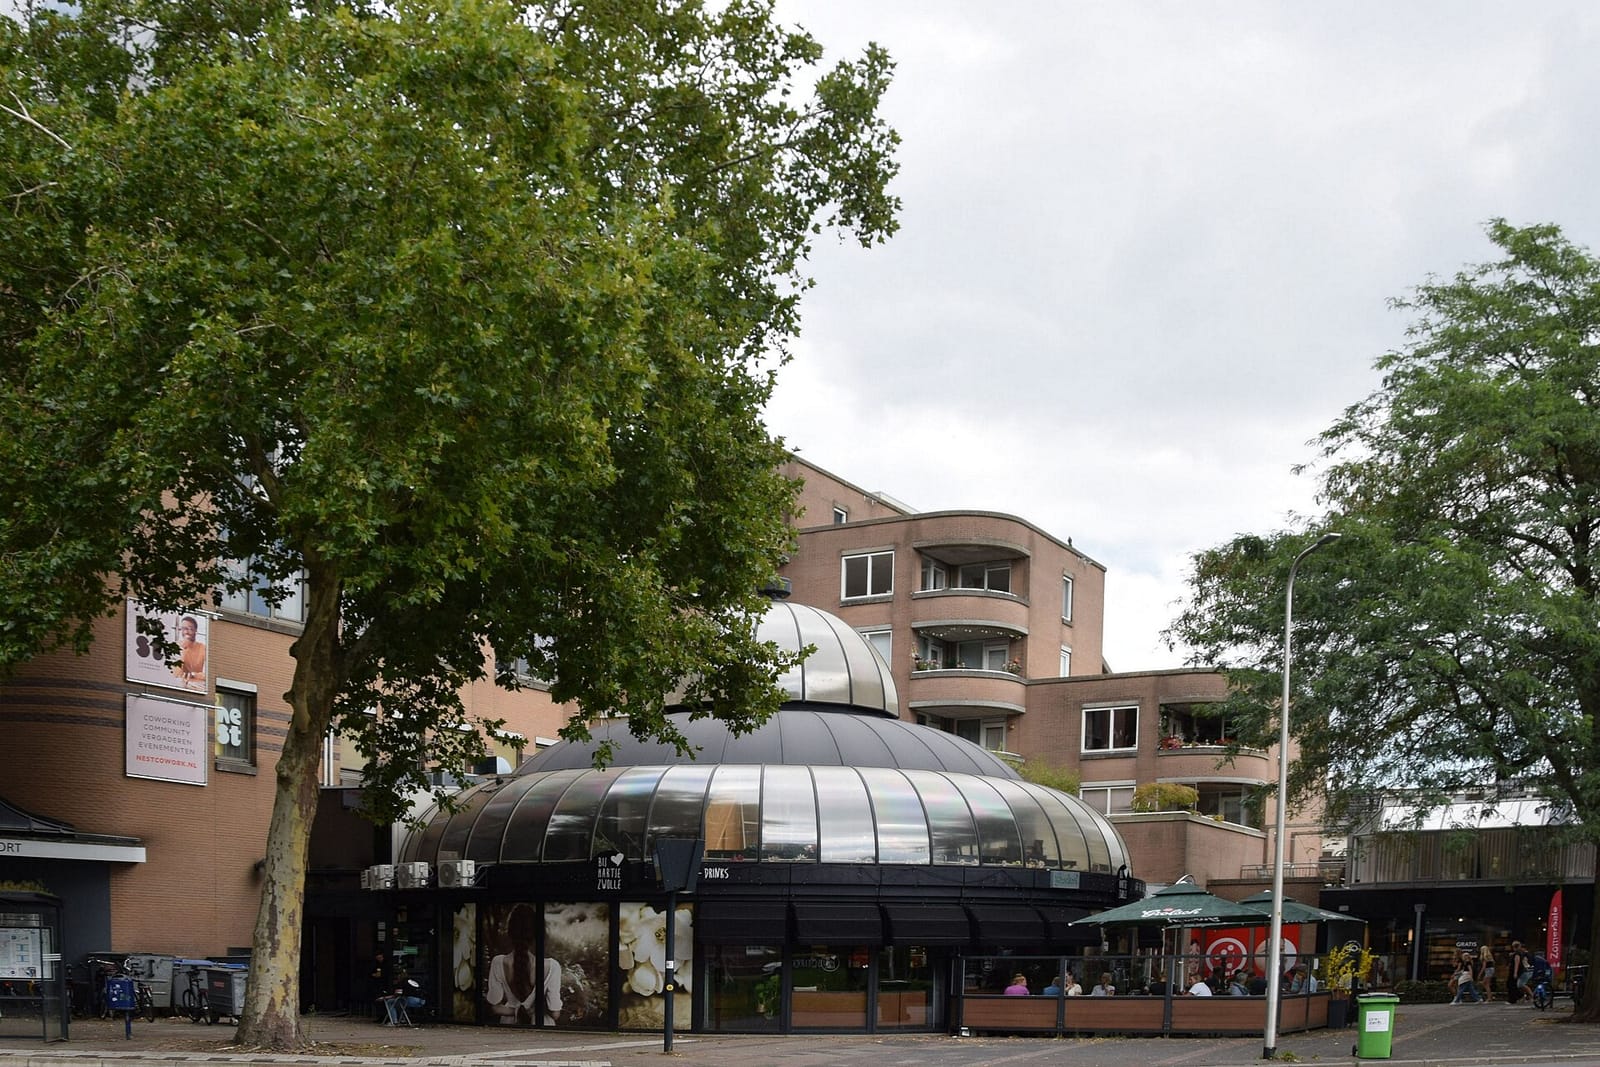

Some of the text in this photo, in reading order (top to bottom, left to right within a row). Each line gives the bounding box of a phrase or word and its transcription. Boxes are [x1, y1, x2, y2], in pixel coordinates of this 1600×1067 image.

[144, 714, 191, 728] COWORKING
[143, 723, 191, 737] COMMUNITY
[217, 723, 242, 747] st
[142, 733, 192, 746] VERGADEREN
[138, 741, 195, 755] EVENEMENTEN
[136, 754, 198, 769] NESTCOWORK.NL
[704, 868, 729, 879] DRINKS
[597, 879, 622, 890] ZWOLLE
[1550, 906, 1559, 959] ZomerSale
